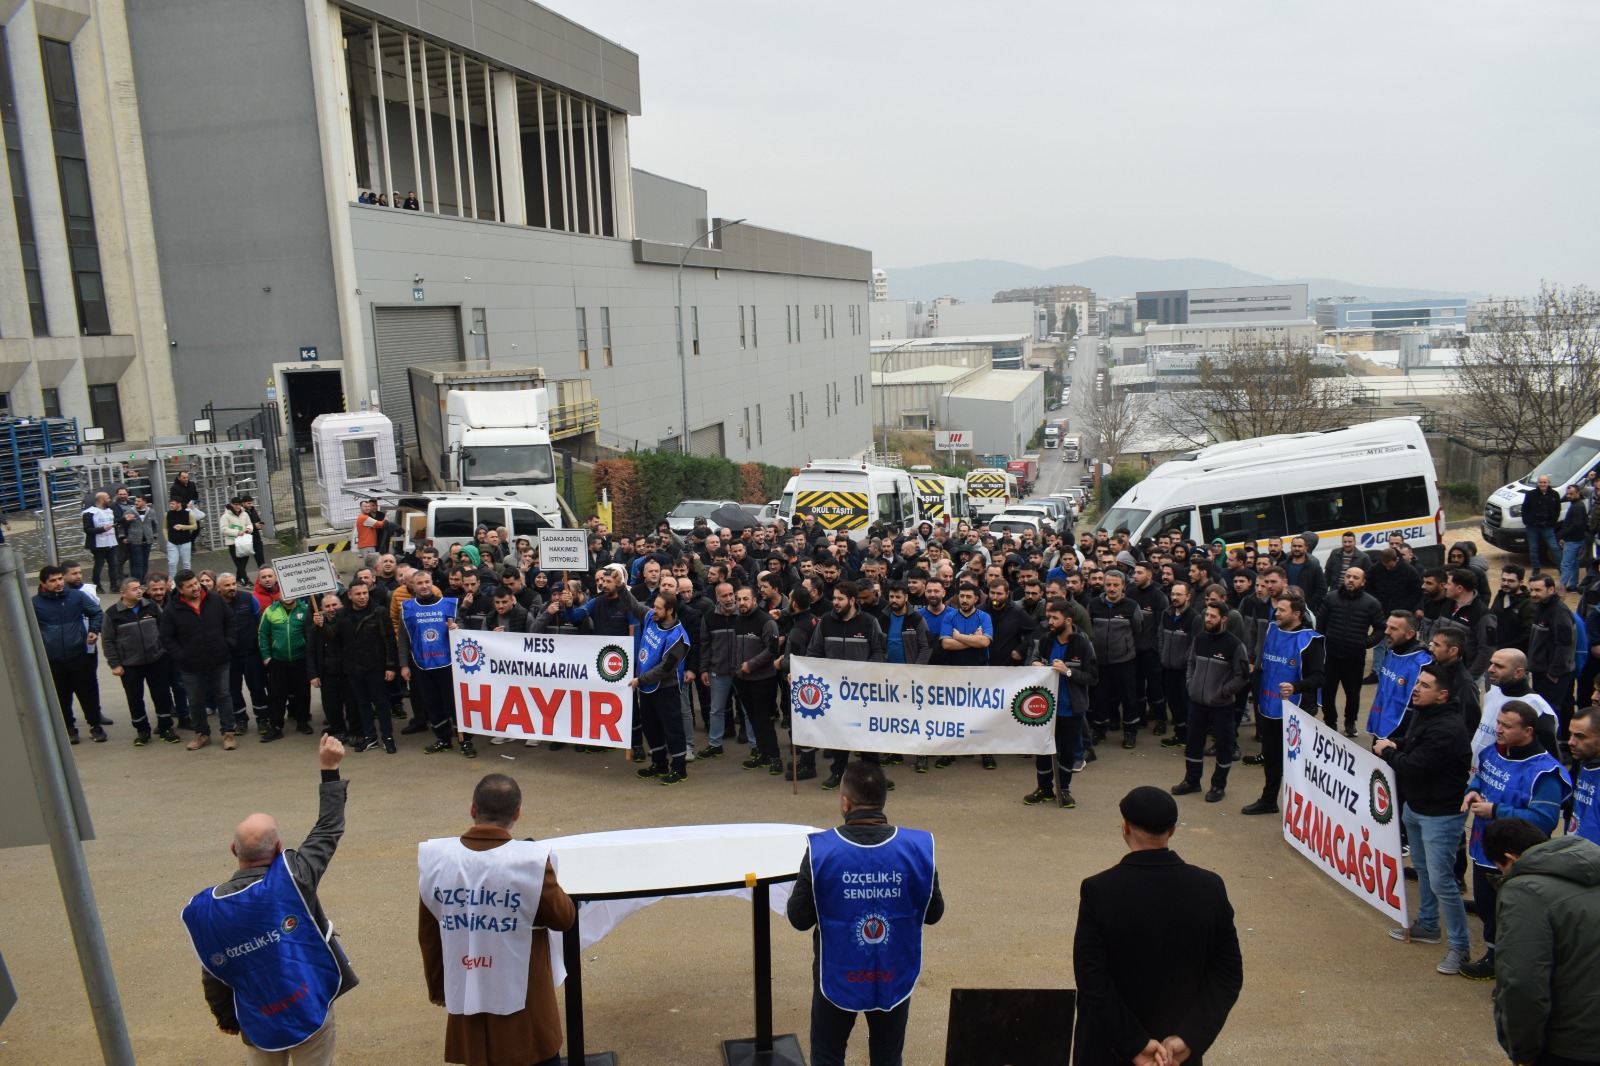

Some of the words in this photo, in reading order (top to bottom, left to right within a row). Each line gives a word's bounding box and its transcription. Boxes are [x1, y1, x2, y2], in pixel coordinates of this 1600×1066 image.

[302, 350, 316, 358] K-6
[920, 495, 940, 503] AŞITI
[811, 506, 830, 514] OKUL
[832, 506, 853, 516] TAŞITI
[283, 570, 303, 578] ÜRETİM
[291, 585, 307, 593] AİLESİ
[307, 581, 328, 590] GÜLSÜN
[523, 637, 555, 653] MESS
[490, 658, 588, 680] DAYATMALARINA
[839, 676, 899, 707] ÖZÇELİK
[911, 679, 924, 710] İŞ
[928, 682, 1005, 710] SENDİKASI
[459, 682, 623, 743] HAYIR
[868, 716, 920, 735] BURSA
[925, 719, 965, 740] ŞUBE
[1312, 726, 1355, 777] İŞÇİYİZ
[1304, 758, 1359, 815] HAKLIYIZ
[1284, 782, 1401, 911] AZANACAĞIZ
[842, 870, 902, 886] ÖZÇELİK-İŞ
[433, 886, 522, 912] ÖZÇELİK-İŞ
[843, 887, 901, 899] SENDİKASI
[442, 913, 518, 932] SENİKASI
[226, 929, 281, 958] ÖZÇELİK-İŞ
